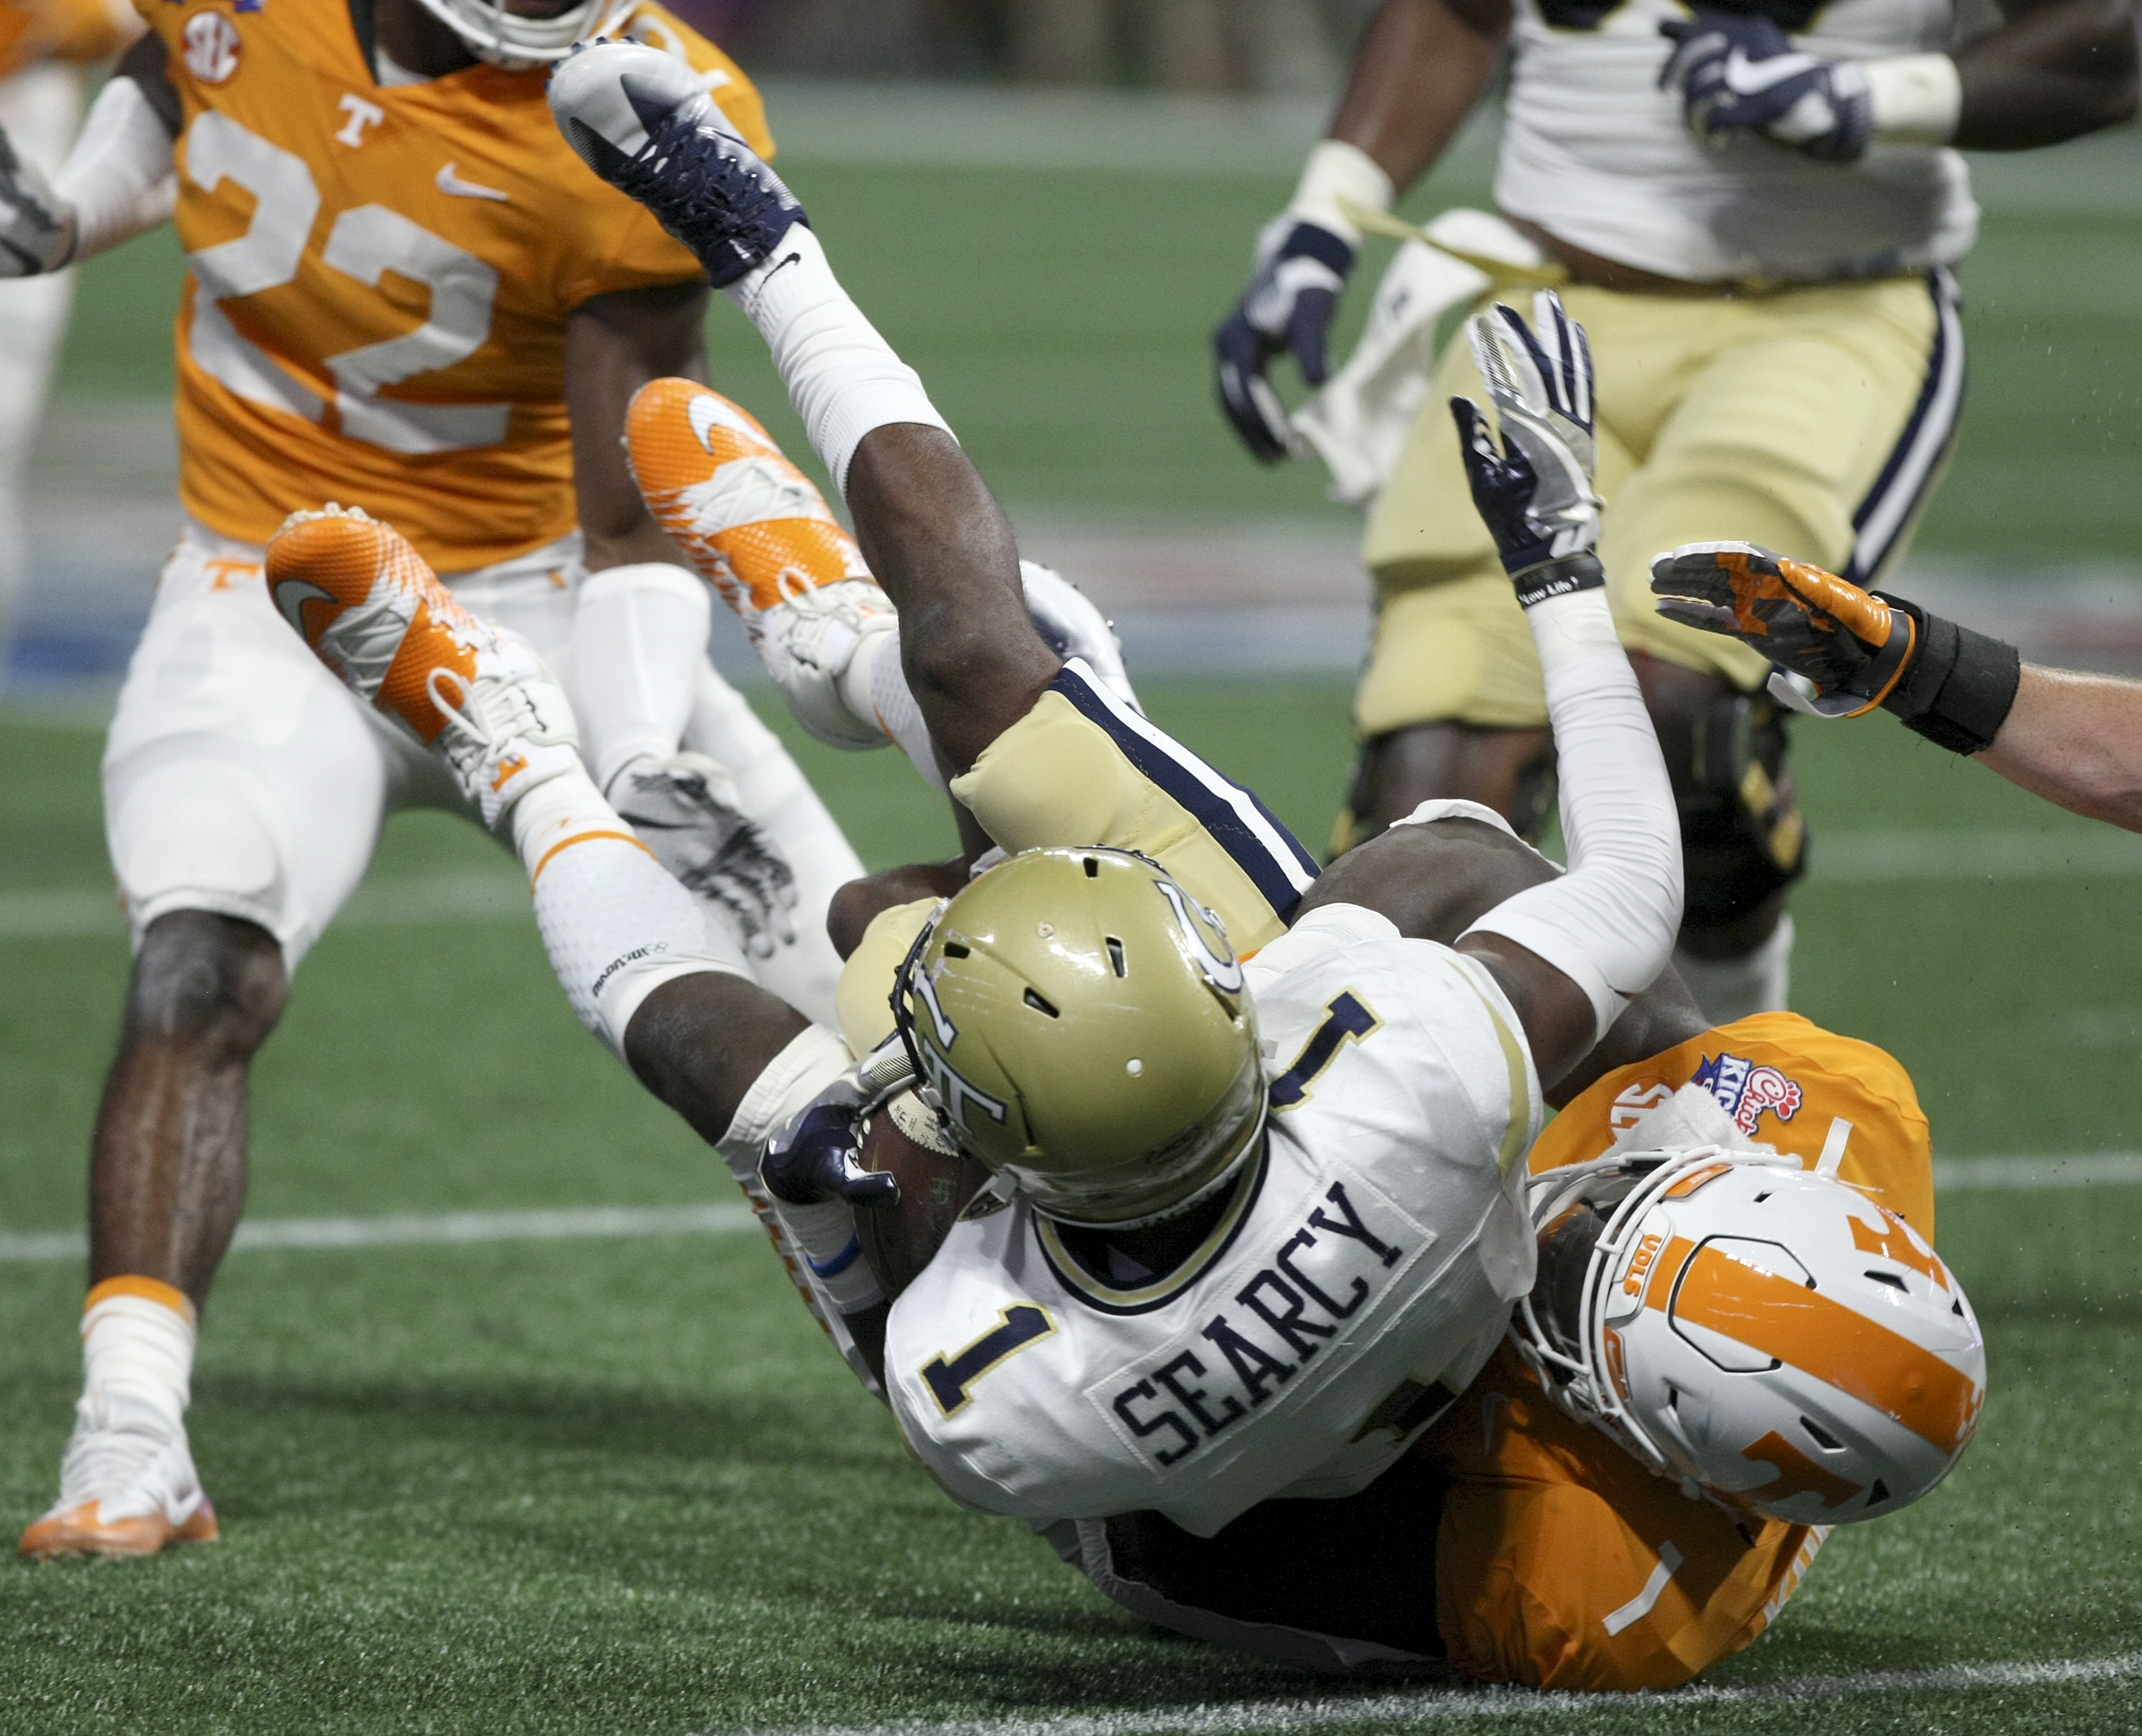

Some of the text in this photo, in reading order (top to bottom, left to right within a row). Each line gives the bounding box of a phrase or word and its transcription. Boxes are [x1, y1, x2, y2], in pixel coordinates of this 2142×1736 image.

[336, 93, 384, 147] T
[185, 109, 511, 454] 22
[1266, 985, 1386, 1113] 1
[918, 1300, 1059, 1420] 1
[1112, 1182, 1405, 1467] SEARCY
